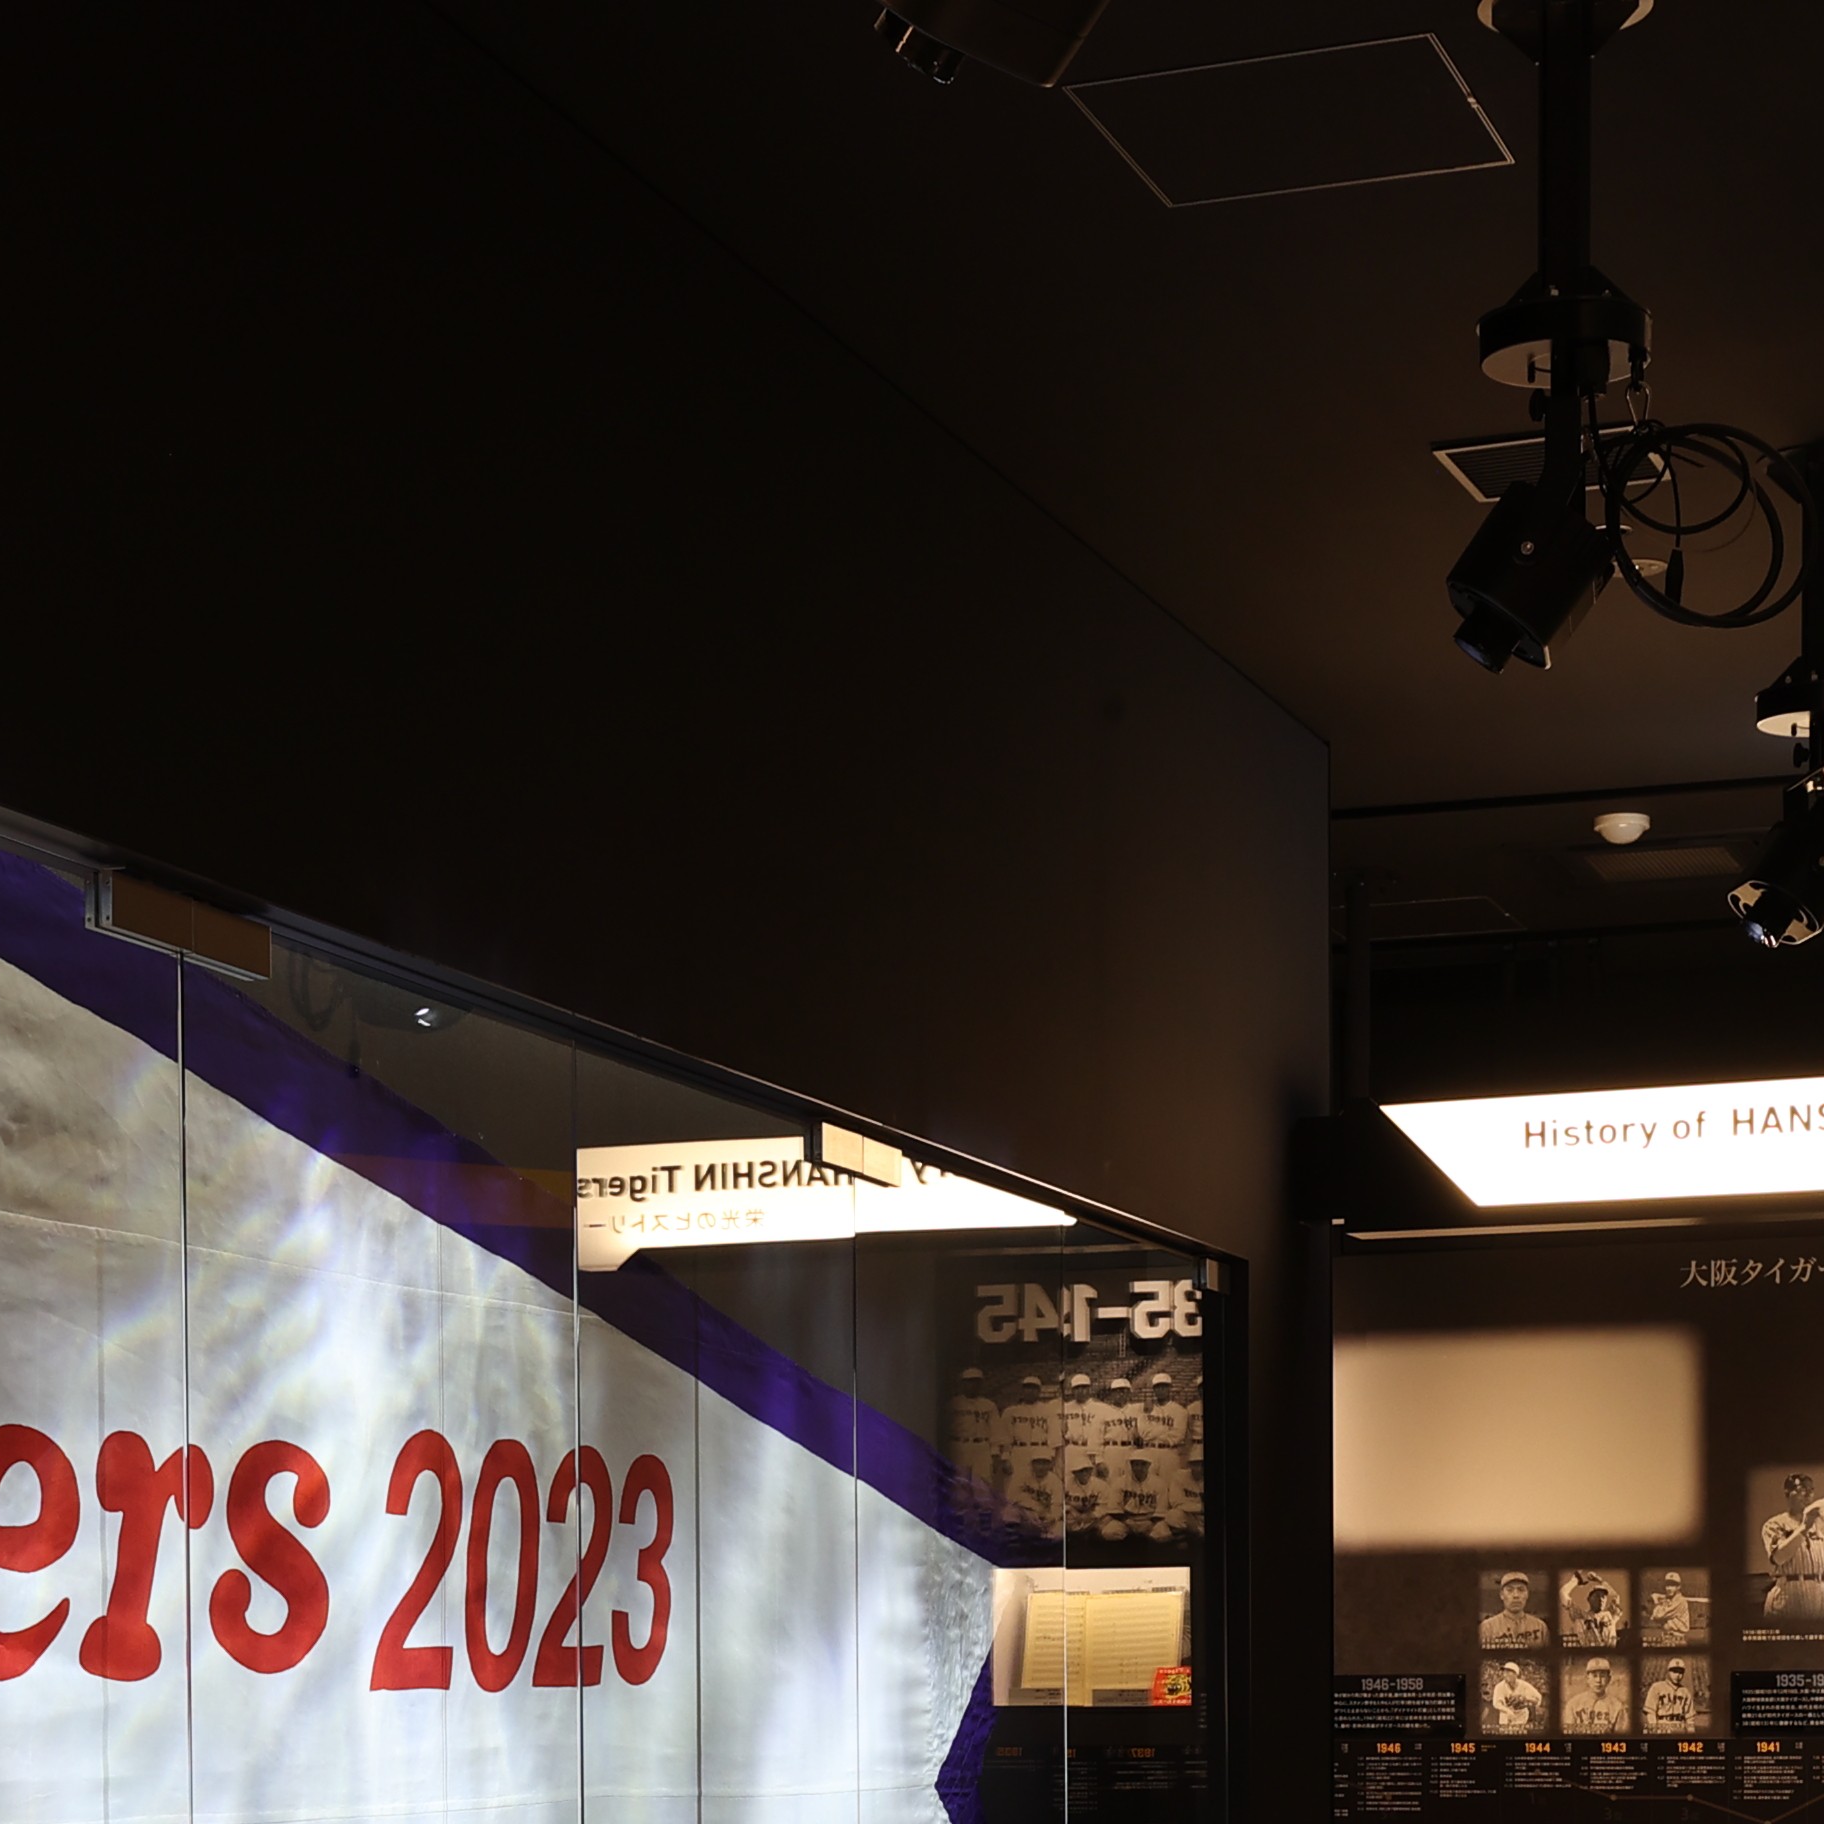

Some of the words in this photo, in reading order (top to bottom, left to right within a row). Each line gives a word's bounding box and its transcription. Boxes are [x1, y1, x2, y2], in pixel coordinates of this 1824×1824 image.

[1524, 1117, 1655, 1149] History
[1673, 1111, 1707, 1141] of
[368, 1430, 674, 1691] 2023
[1361, 1678, 1424, 1691] 1946-1958
[1376, 1743, 1401, 1753] 1946
[1451, 1743, 1476, 1753] 1945
[1525, 1742, 1551, 1753] 1944
[1601, 1742, 1626, 1753] 1943
[1677, 1742, 1703, 1753] 1942
[1756, 1741, 1780, 1753] 1941
